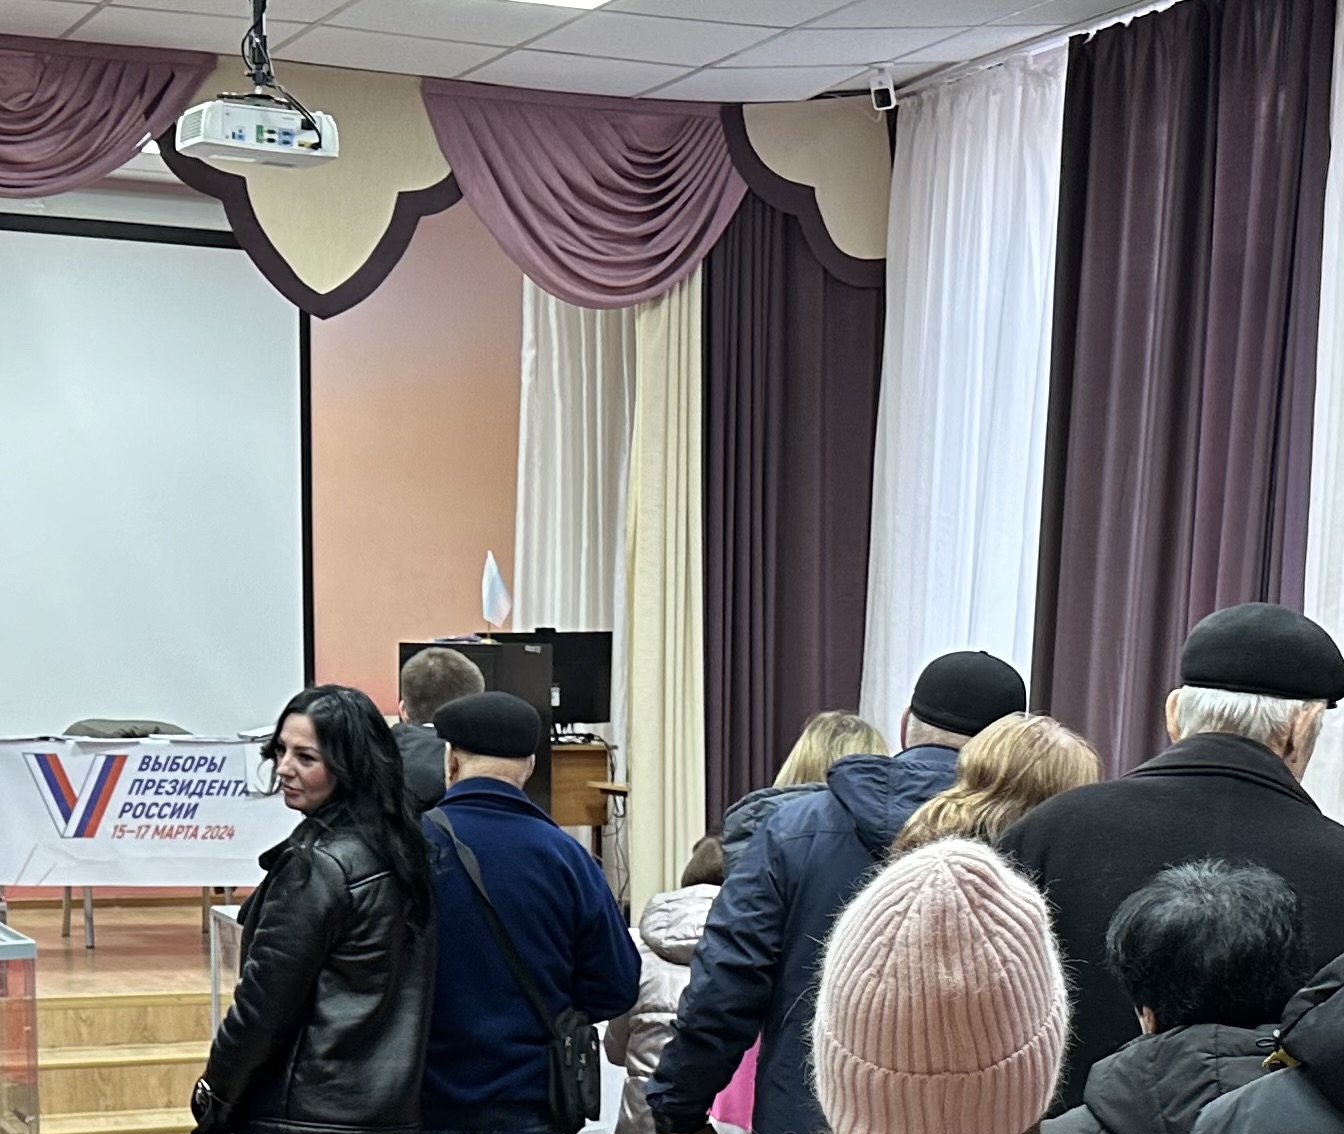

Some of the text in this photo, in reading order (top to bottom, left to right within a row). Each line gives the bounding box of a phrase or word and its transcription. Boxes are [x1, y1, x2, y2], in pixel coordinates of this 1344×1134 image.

[138, 755, 227, 773] ВЫБОРЫ
[128, 778, 250, 798] ПРЕЗИДЕНТА
[118, 802, 199, 819] РОССИИ
[151, 824, 200, 839] МАРТА
[201, 825, 235, 840] 2024
